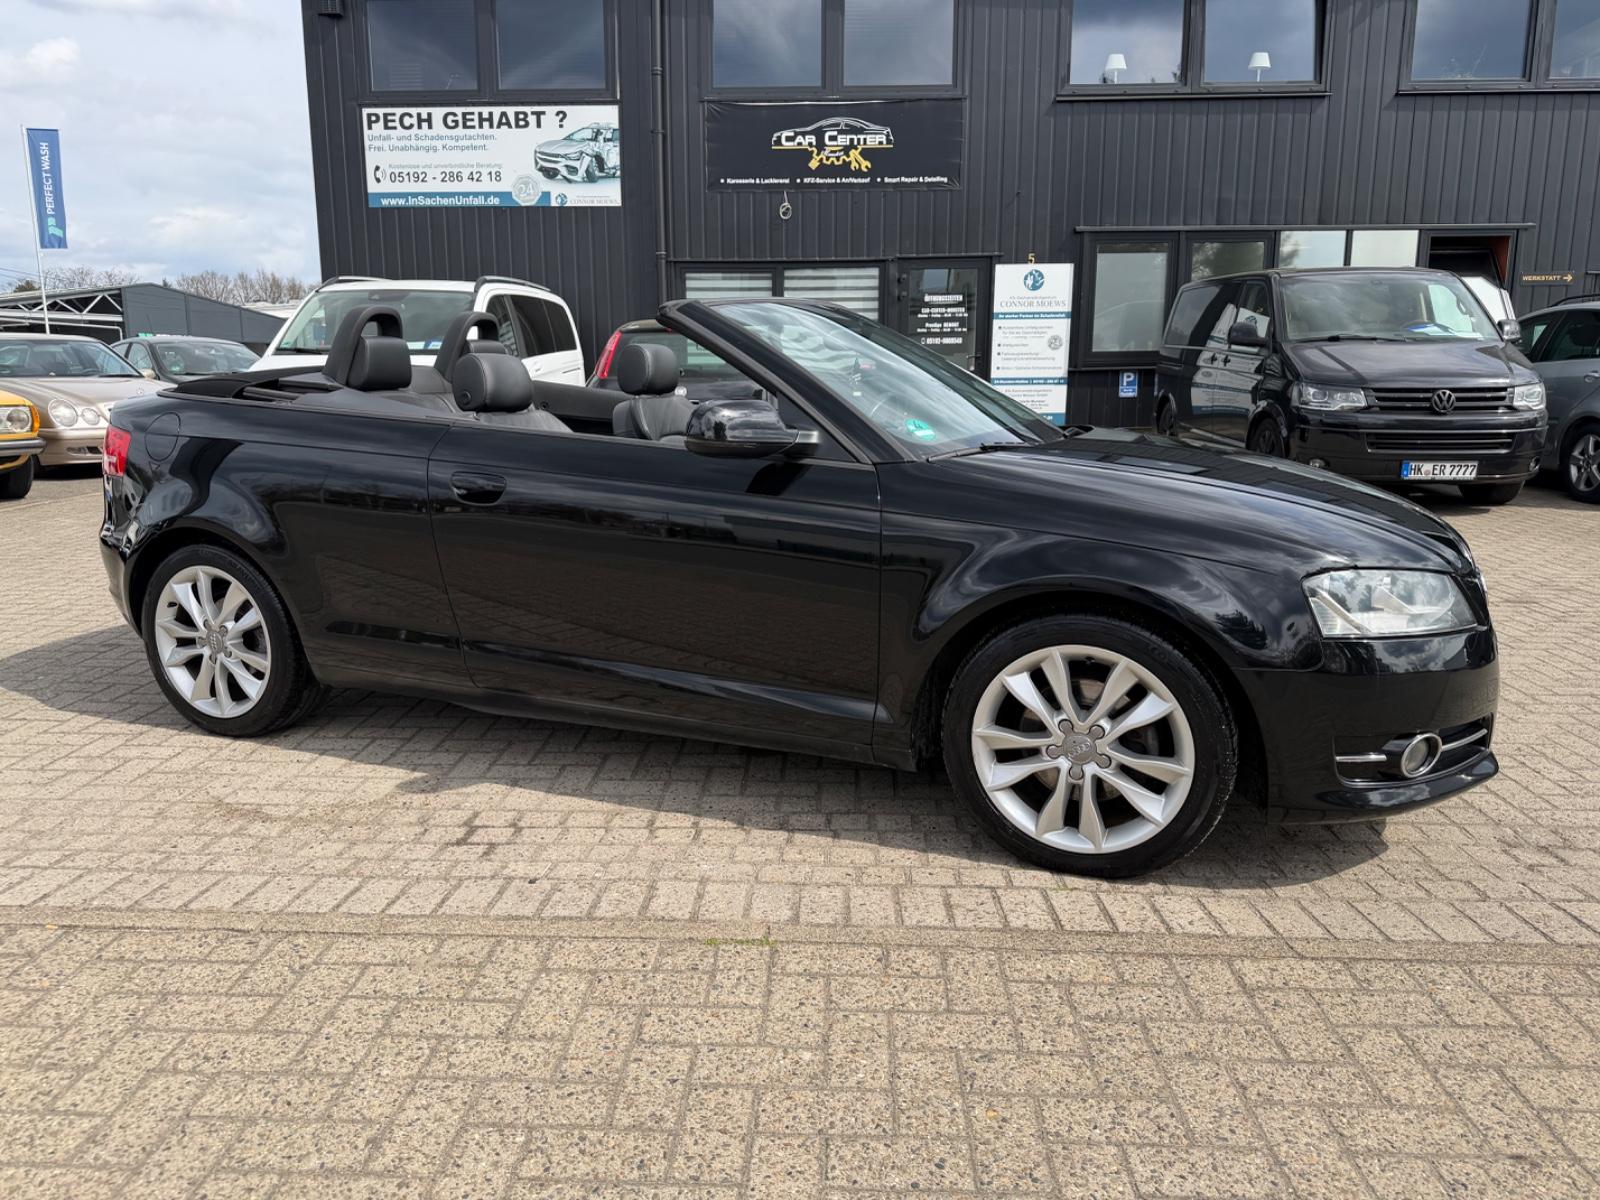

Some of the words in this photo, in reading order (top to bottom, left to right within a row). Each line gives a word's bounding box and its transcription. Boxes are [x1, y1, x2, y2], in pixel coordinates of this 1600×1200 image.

[366, 112, 433, 130] PECH
[442, 111, 546, 130] GEHABT
[555, 110, 568, 129] ?
[367, 134, 394, 142] Unfall-
[396, 133, 411, 141] und
[414, 132, 497, 142] Schadensgutachten.
[781, 131, 816, 146] CAR
[824, 131, 887, 146] CENTER
[368, 144, 387, 152] Frei.
[388, 143, 439, 153] Unabhängig.
[442, 142, 488, 152] Kompetent.
[40, 142, 50, 170] WASH
[389, 171, 428, 183] 05192
[440, 171, 463, 183] 286
[467, 170, 483, 182] 42
[487, 170, 502, 182] 18
[42, 172, 56, 215] PERFECT
[381, 195, 500, 205] www.InSachenUnfall.de
[1028, 253, 1036, 264] 5
[1000, 300, 1034, 308] CONNOR
[1036, 299, 1066, 307] MOEWS
[1123, 372, 1135, 386] P
[1410, 464, 1424, 475] HK
[1432, 464, 1447, 475] ER
[1449, 464, 1477, 475] 7777
